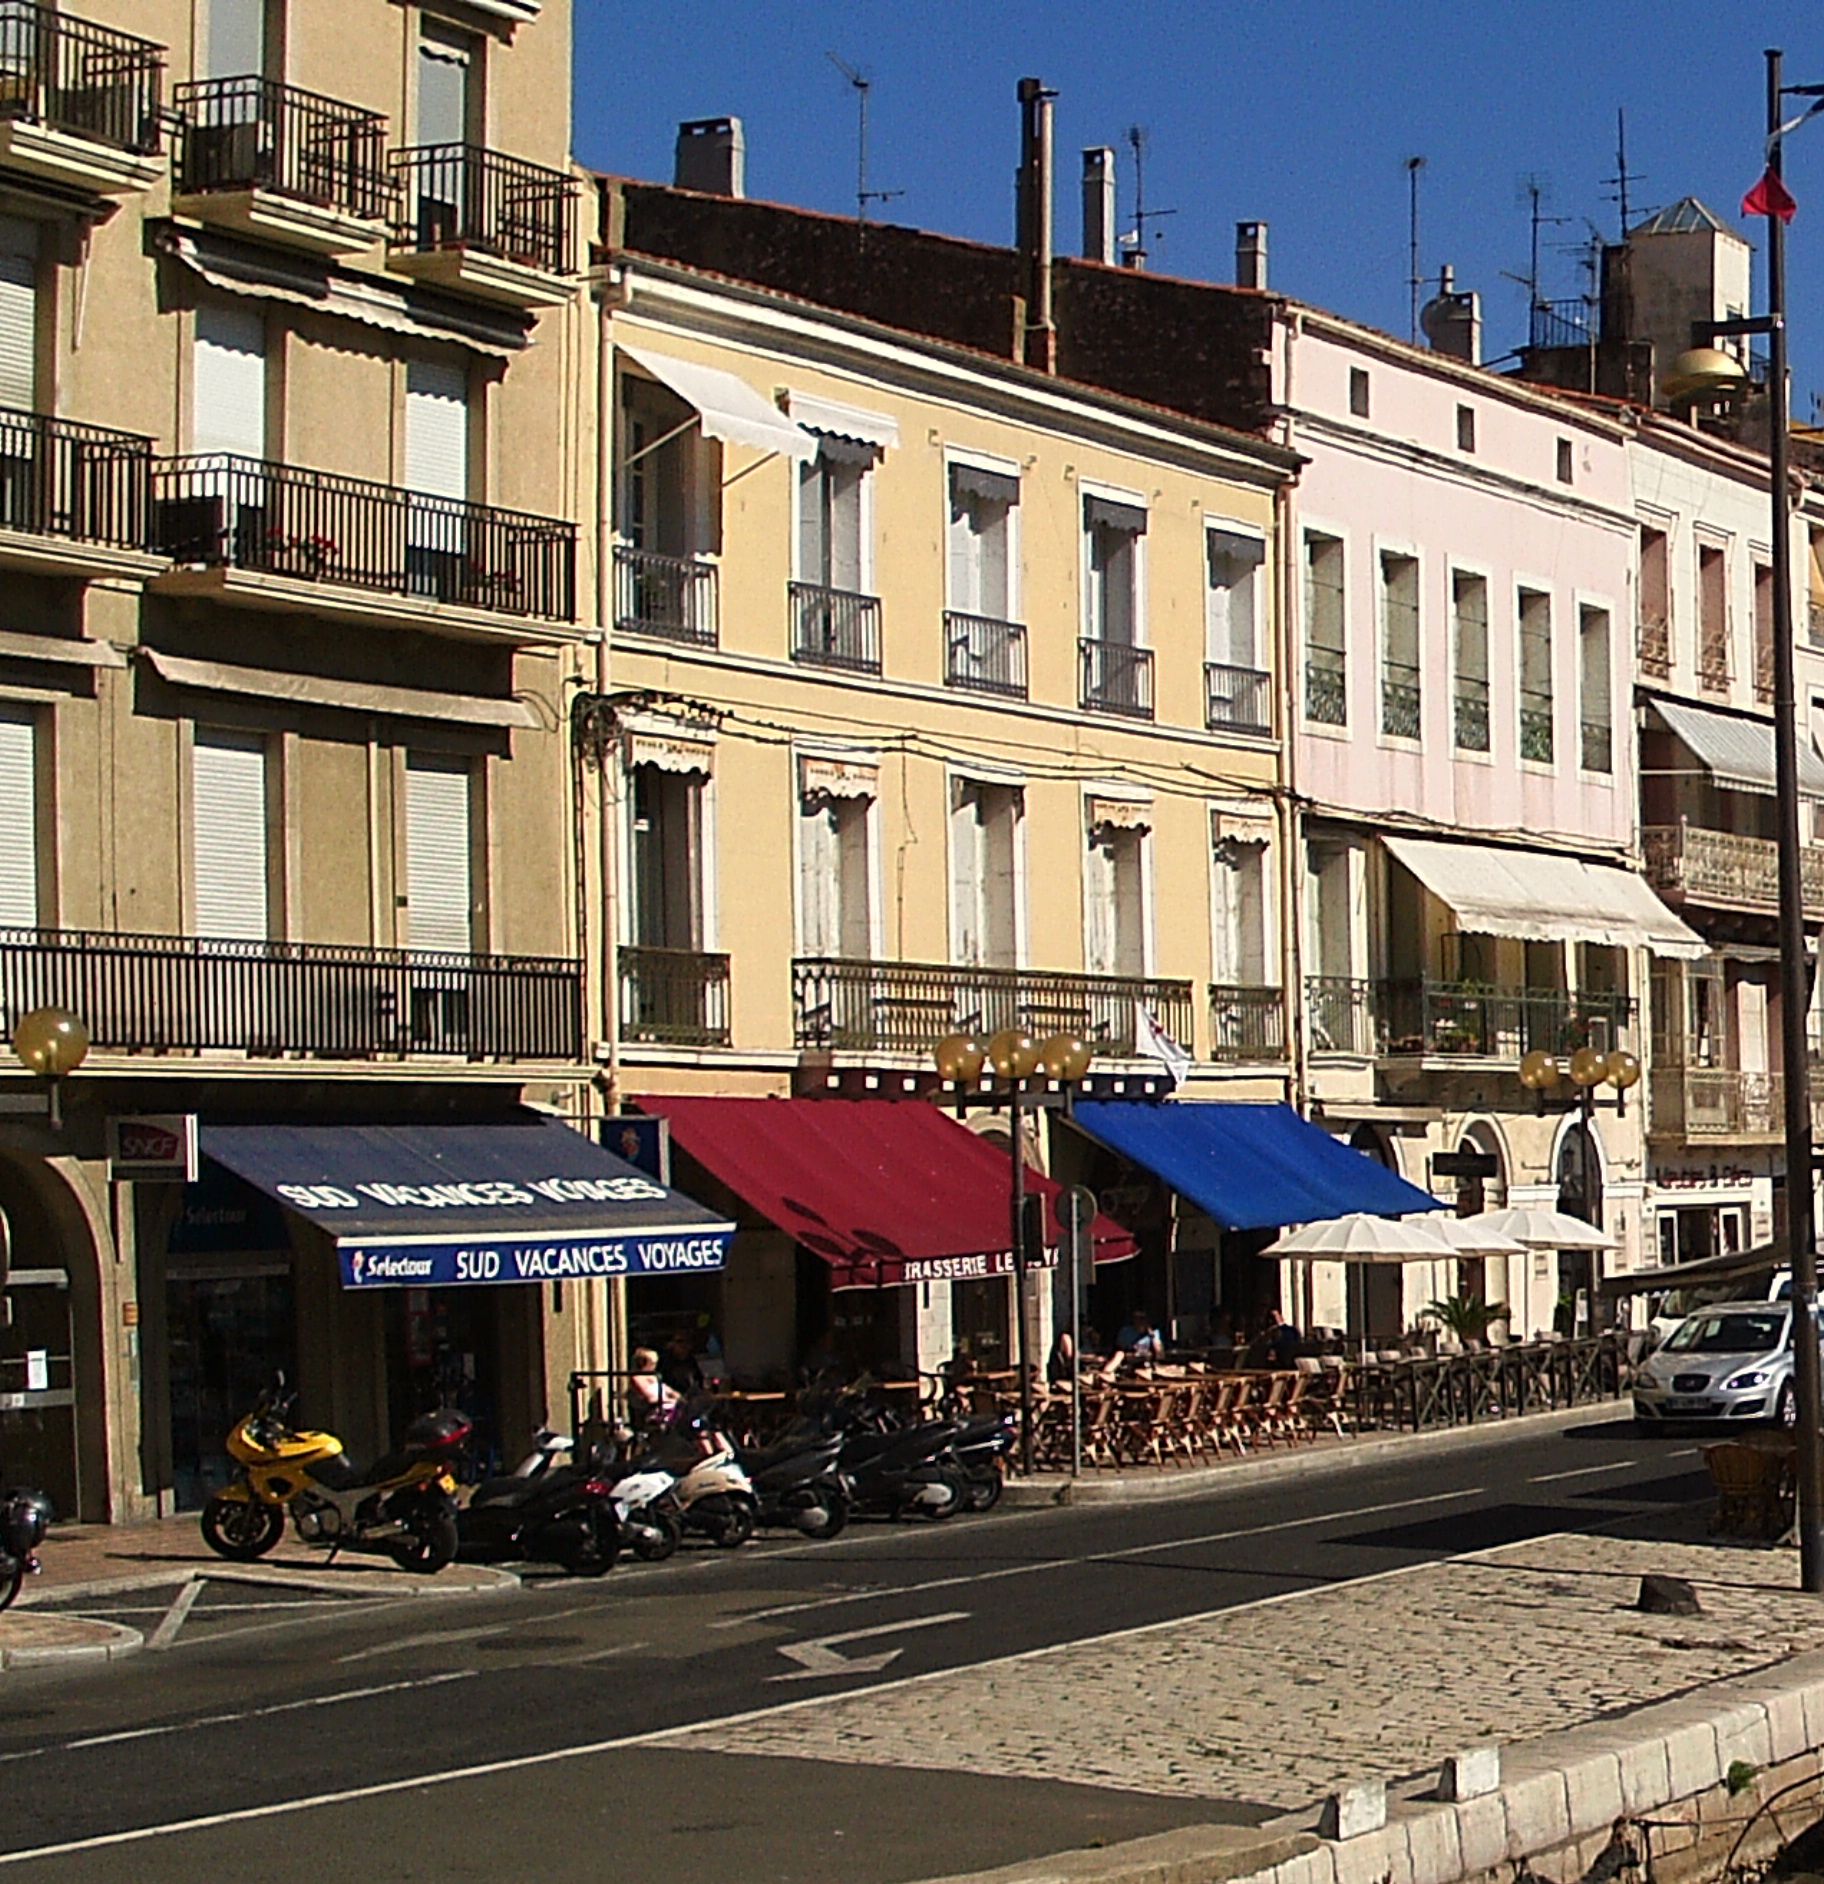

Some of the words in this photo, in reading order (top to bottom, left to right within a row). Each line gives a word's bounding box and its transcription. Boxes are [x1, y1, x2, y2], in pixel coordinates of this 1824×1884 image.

[121, 1137, 175, 1157] SNCF
[277, 1183, 359, 1208] SUD
[355, 1181, 533, 1207] VACANCES
[526, 1178, 667, 1202] VOYAGES
[366, 1255, 433, 1278] Selectour
[456, 1250, 500, 1280] SUD
[515, 1243, 628, 1277] VACANCES
[638, 1239, 723, 1270] VOYAGES
[995, 1251, 1014, 1273] LE
